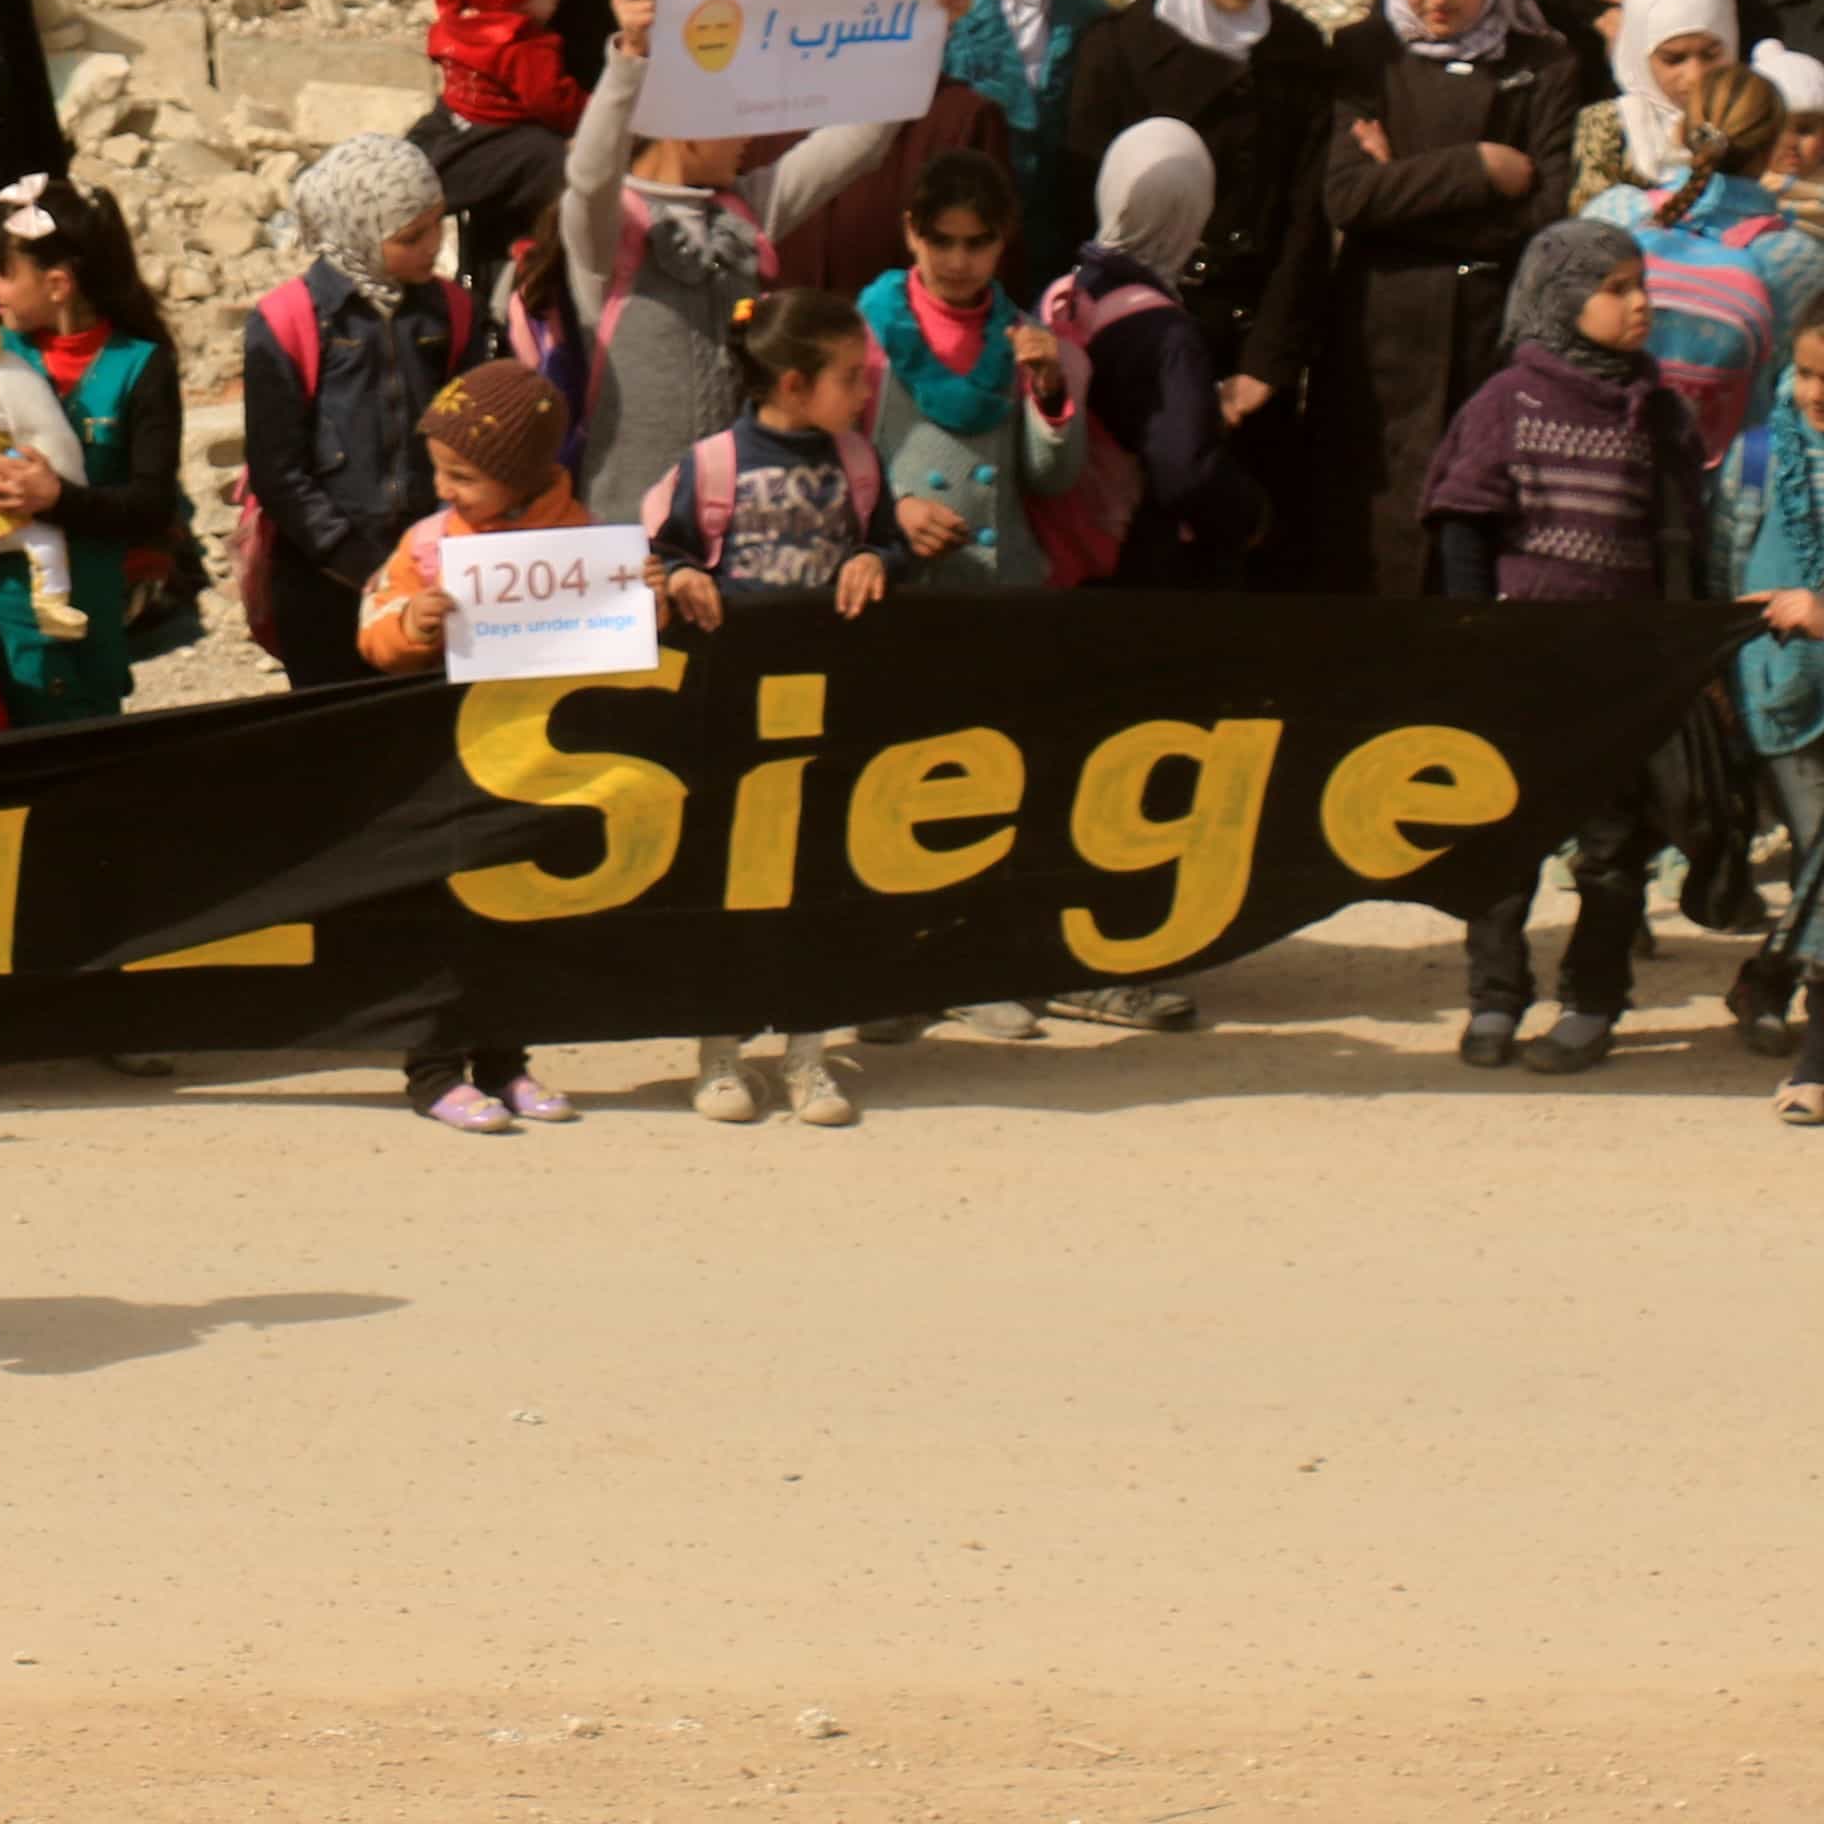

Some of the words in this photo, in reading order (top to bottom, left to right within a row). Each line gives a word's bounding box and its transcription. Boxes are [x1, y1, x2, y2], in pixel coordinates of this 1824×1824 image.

[789, 0, 919, 59] للشرب
[464, 557, 590, 607] 1204
[527, 616, 581, 633] under
